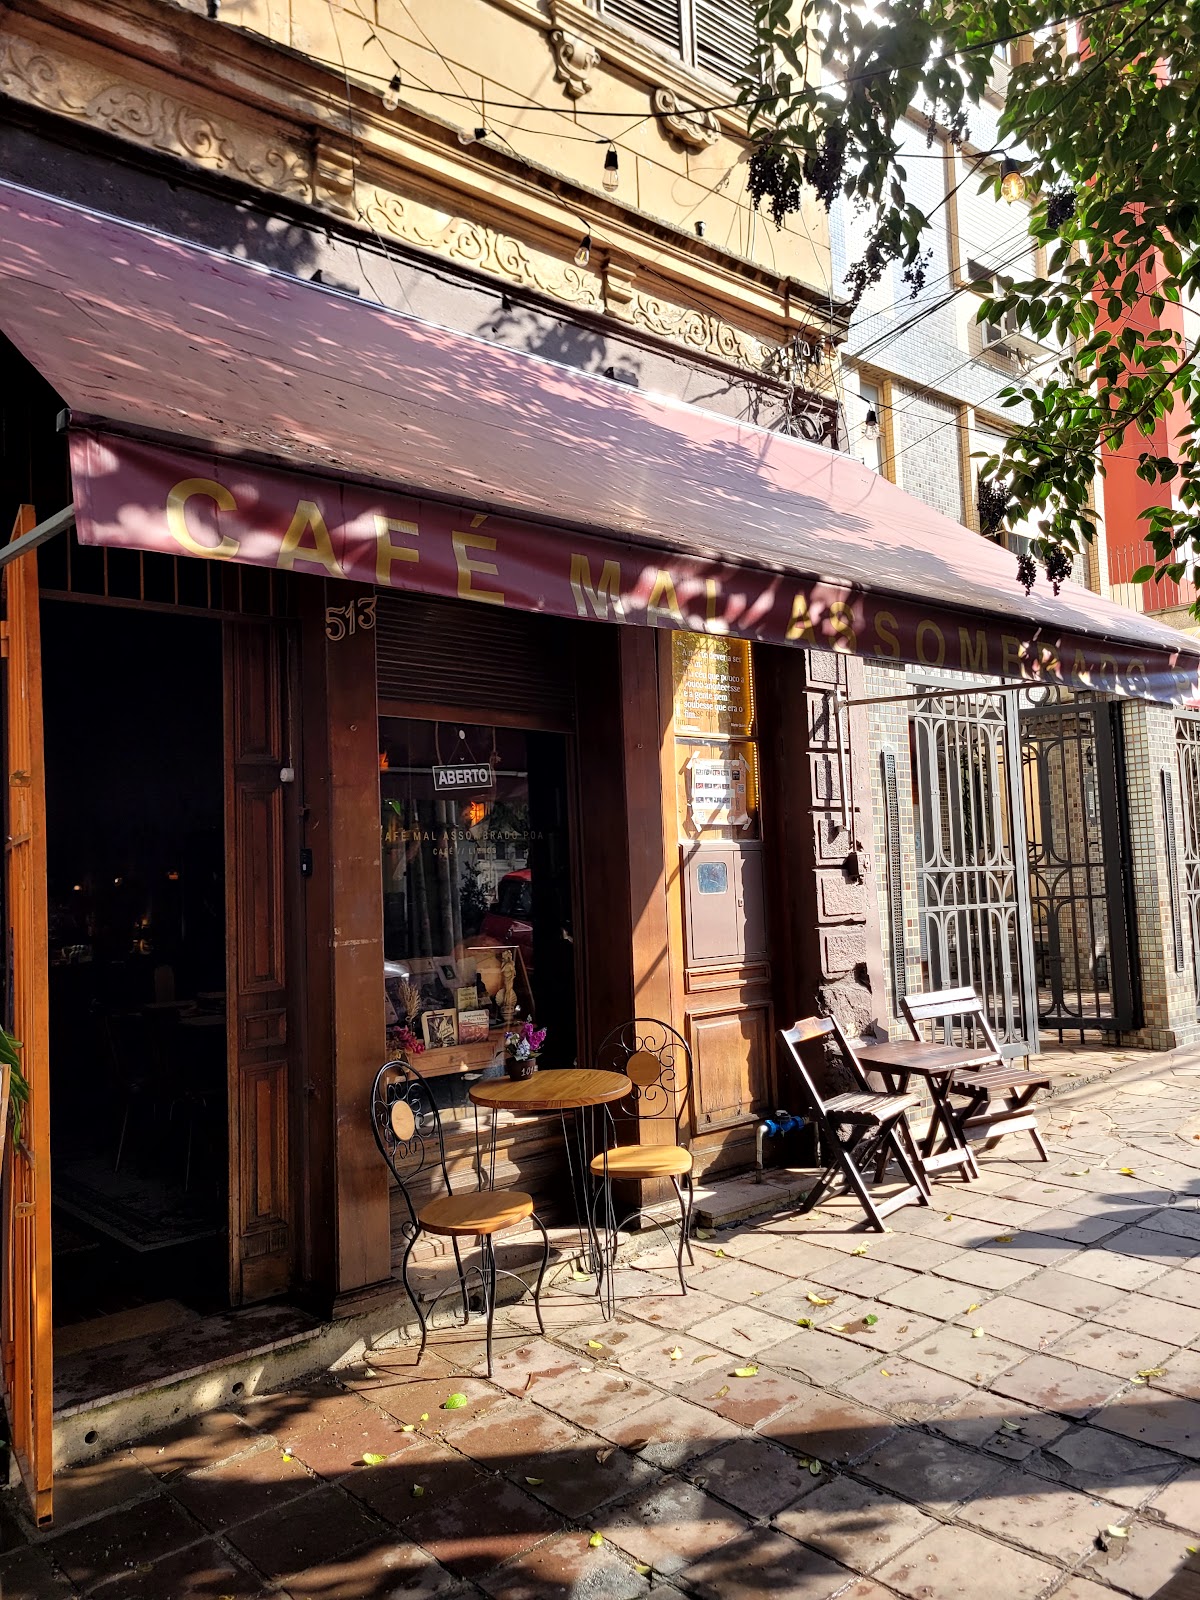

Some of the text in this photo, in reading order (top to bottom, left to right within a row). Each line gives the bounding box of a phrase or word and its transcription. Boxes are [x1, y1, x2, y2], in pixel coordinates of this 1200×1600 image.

[165, 478, 505, 606] CAFÉ
[570, 553, 740, 638] MAL
[785, 594, 1151, 699] ASSOMBRADO
[325, 595, 377, 641] 513
[709, 652, 731, 661] deveria
[732, 656, 742, 664] ser
[695, 670, 706, 678] céu
[708, 673, 719, 682] que
[720, 674, 739, 683] pouco
[694, 691, 713, 701] gente
[714, 694, 727, 702] nem
[683, 700, 713, 710] soubesse
[714, 703, 727, 712] que
[728, 705, 737, 713] era
[438, 768, 488, 786] ABERTO
[413, 830, 437, 841] MAL
[443, 830, 518, 841] ASSOBRADO
[523, 830, 544, 841] POA
[432, 845, 453, 856] CAFÉ
